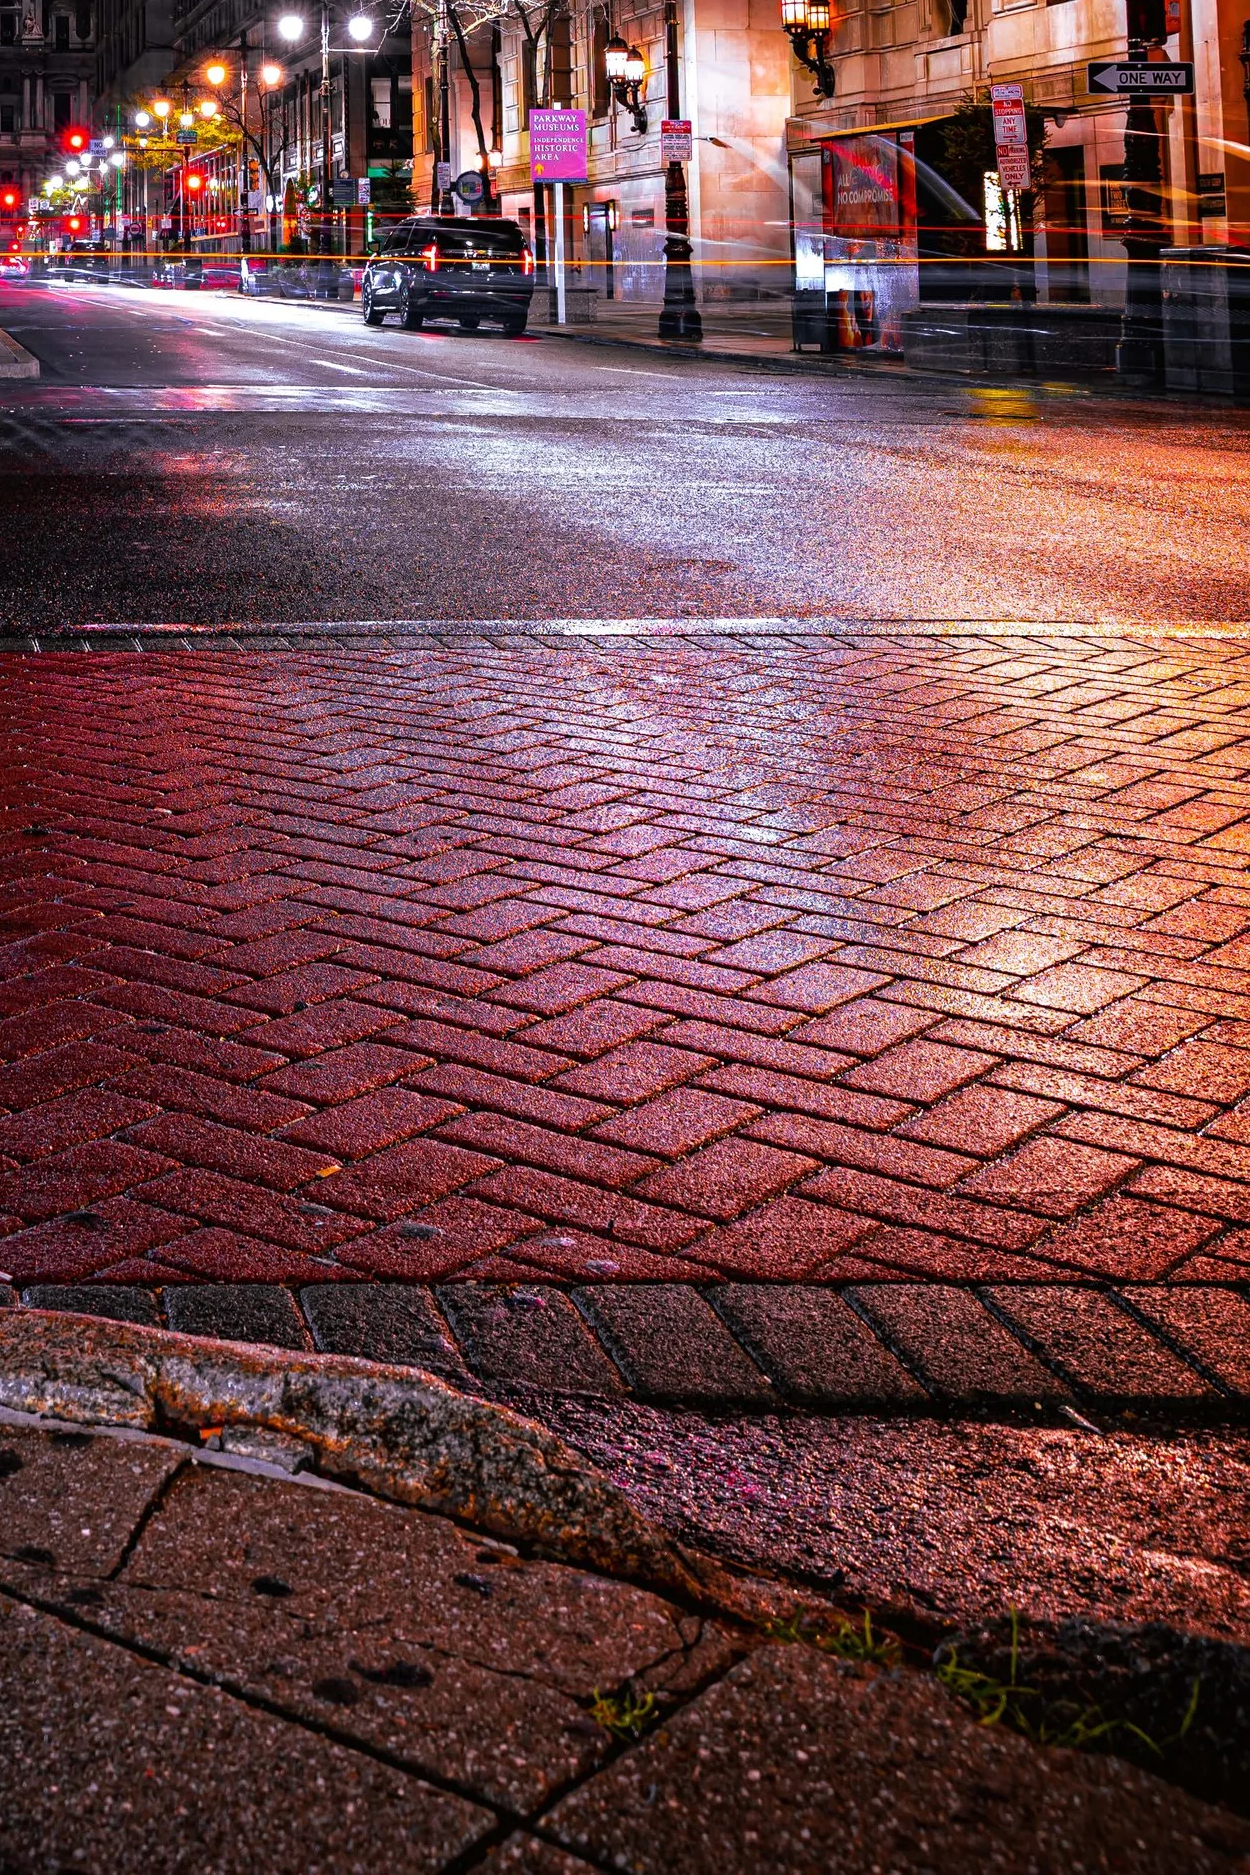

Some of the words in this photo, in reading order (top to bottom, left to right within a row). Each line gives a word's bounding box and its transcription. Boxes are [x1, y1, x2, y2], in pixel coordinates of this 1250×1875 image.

[1119, 72, 1147, 84] ONE
[1152, 72, 1182, 84] WAY
[995, 108, 1022, 116] STOPPING
[534, 115, 577, 123] PARKWAY
[1003, 117, 1016, 125] ANY
[998, 146, 1008, 156] NO
[838, 173, 850, 188] ALL
[1005, 173, 1024, 181] ONLY
[837, 192, 849, 205] NO
[849, 188, 894, 204] COMPROMISE
